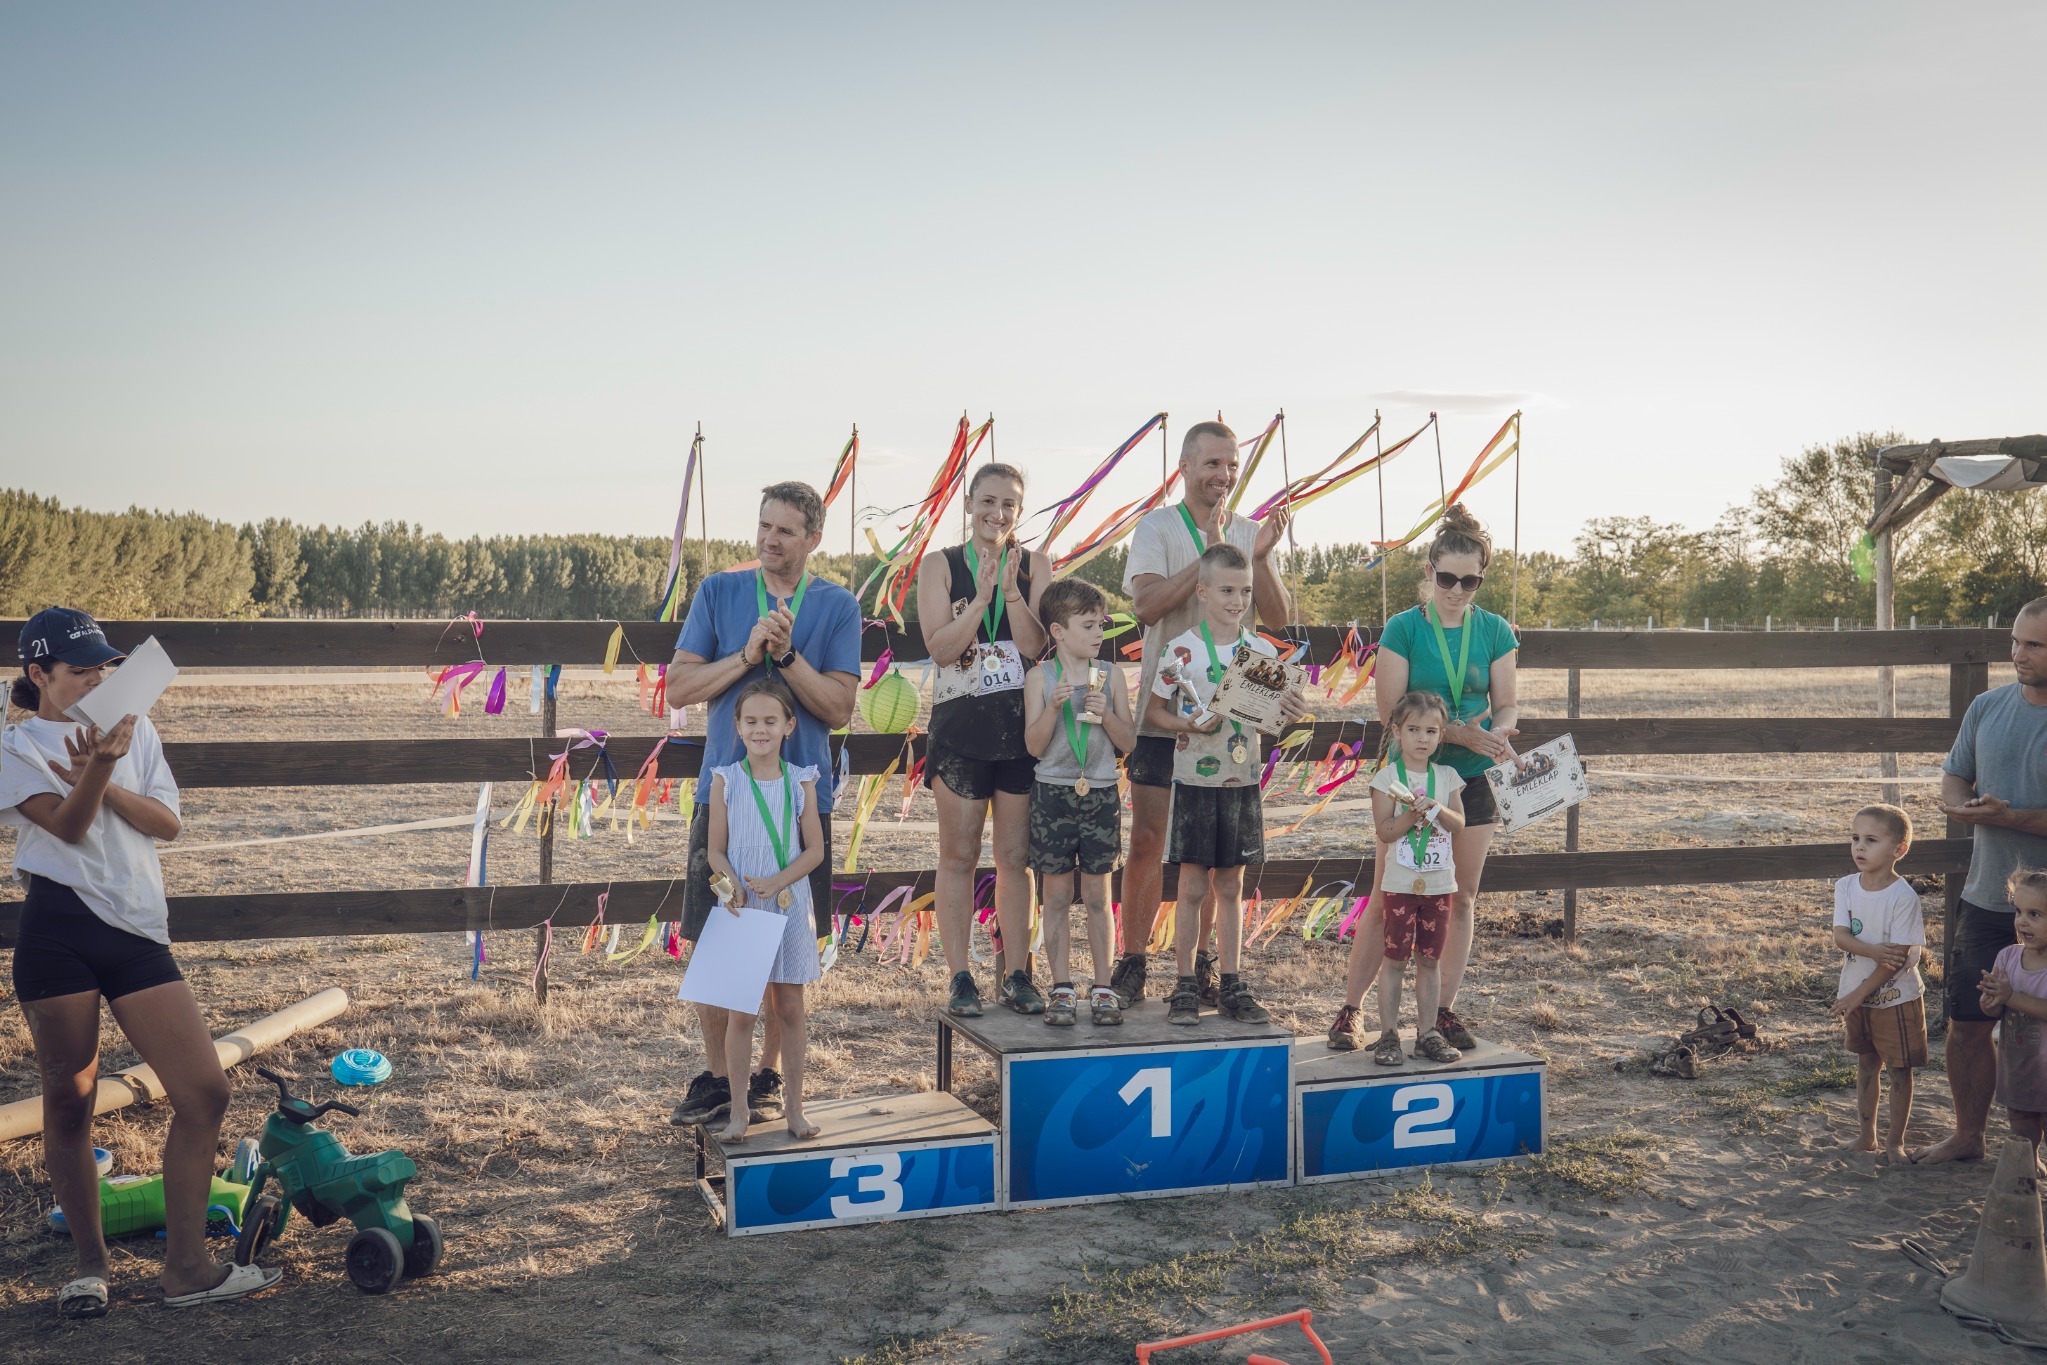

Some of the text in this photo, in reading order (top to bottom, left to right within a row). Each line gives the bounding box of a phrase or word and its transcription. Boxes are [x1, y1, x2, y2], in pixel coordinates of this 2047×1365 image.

[31, 637, 50, 658] 21
[984, 671, 1011, 687] 014
[1118, 1067, 1172, 1138] 1
[1391, 1083, 1456, 1149] 2
[830, 1152, 904, 1219] 3
